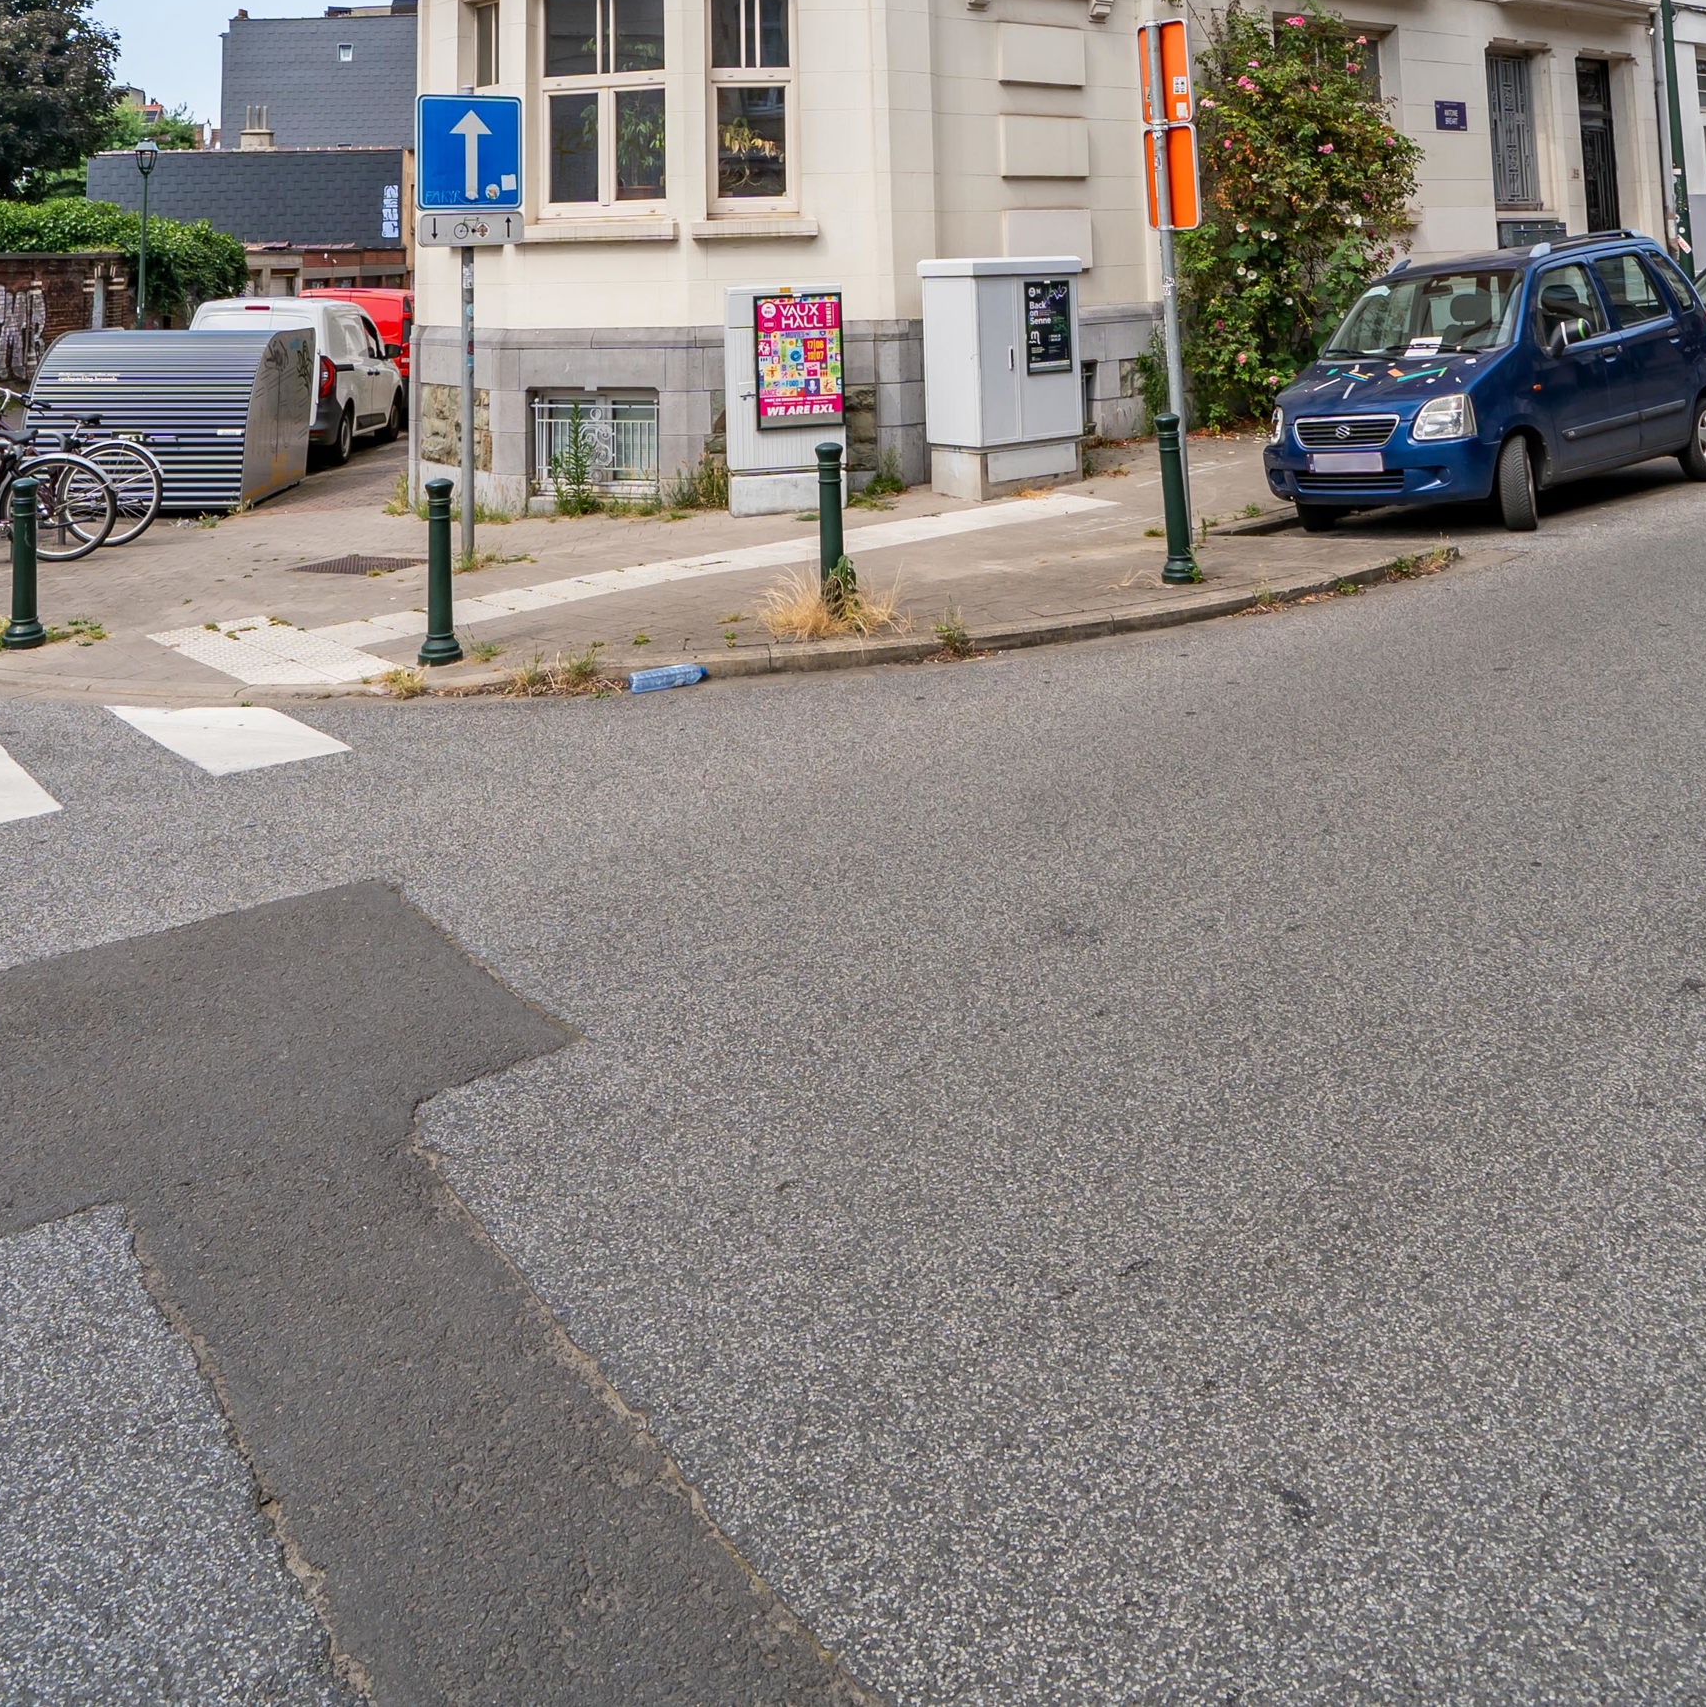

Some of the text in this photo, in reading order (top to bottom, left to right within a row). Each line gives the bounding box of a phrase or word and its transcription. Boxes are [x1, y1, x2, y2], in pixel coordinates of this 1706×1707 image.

[779, 303, 820, 317] VAUX
[1029, 301, 1047, 310] Back
[781, 314, 824, 329] HALL
[1029, 317, 1052, 325] Senne
[767, 403, 835, 416] WE ARE BXL
